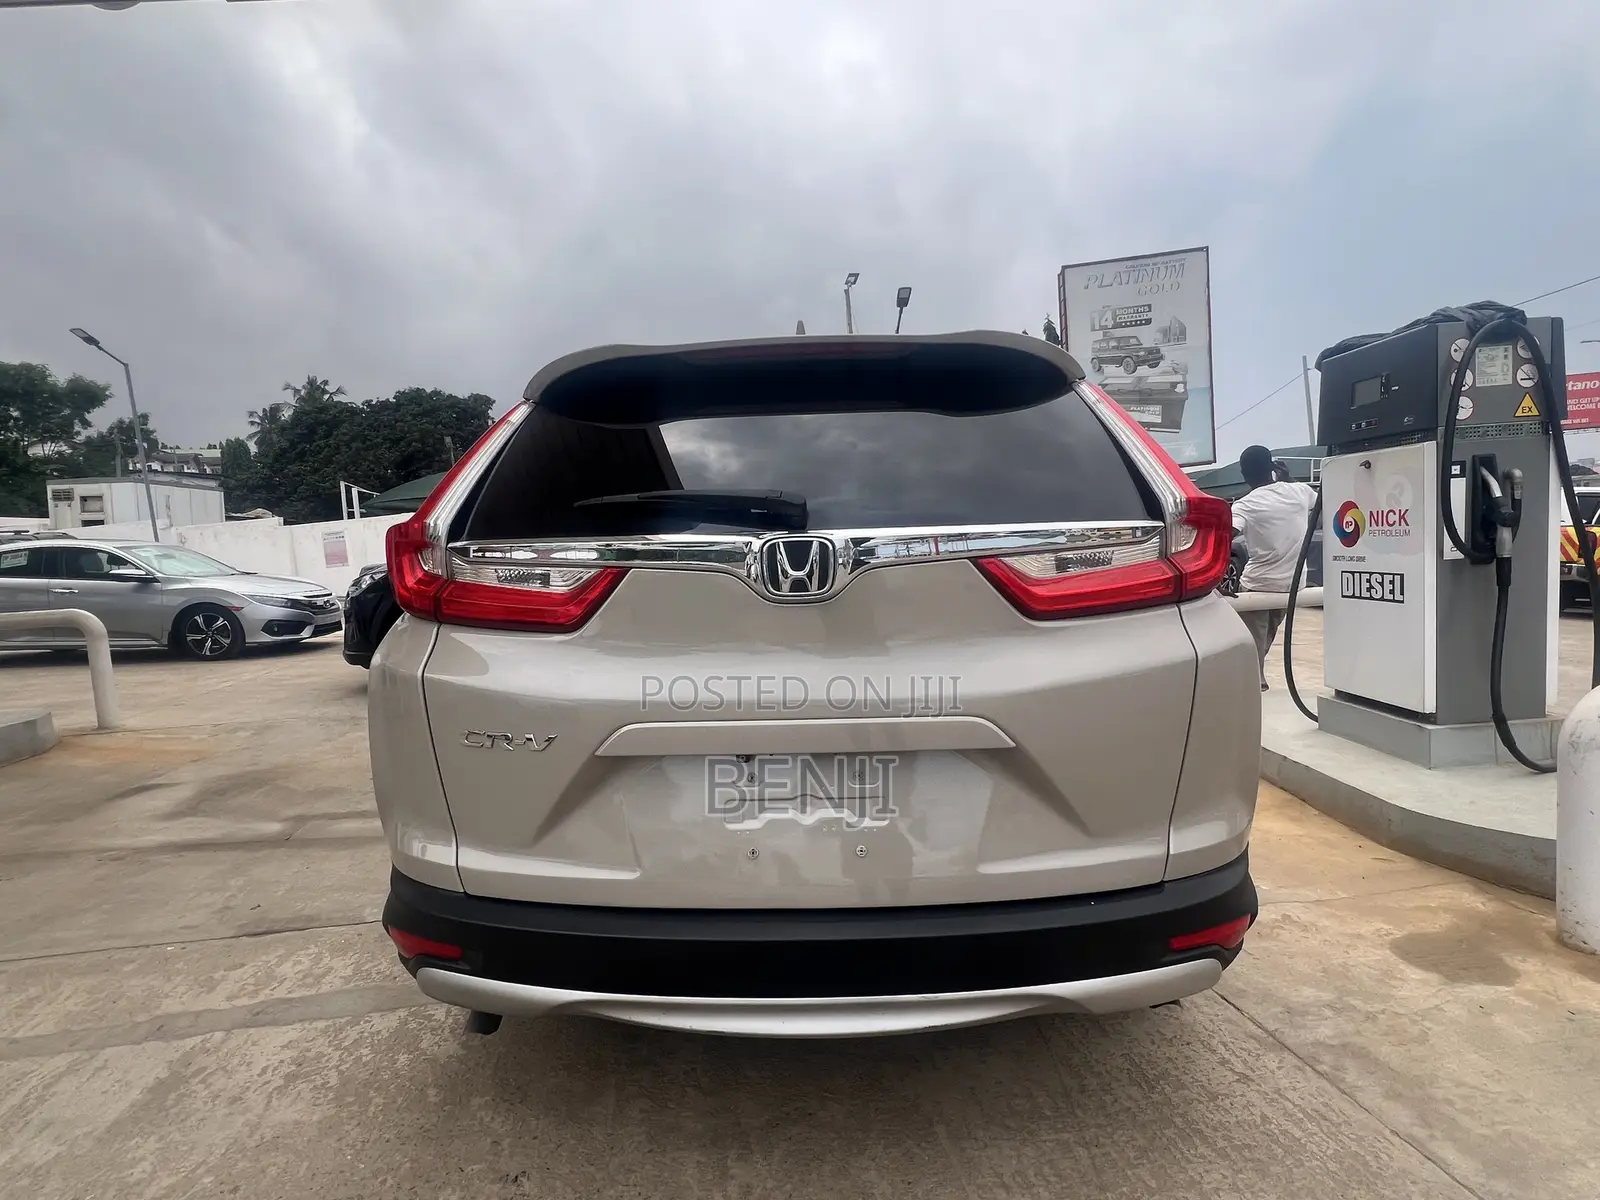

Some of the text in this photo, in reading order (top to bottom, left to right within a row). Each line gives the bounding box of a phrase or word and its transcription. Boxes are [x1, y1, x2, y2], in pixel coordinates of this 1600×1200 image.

[1084, 263, 1185, 289] PLATINUM
[1136, 281, 1180, 296] GOLD
[1116, 305, 1150, 315] MONTHS
[1090, 310, 1114, 330] 14
[1566, 380, 1600, 390] tano
[1521, 406, 1533, 414] EX
[1369, 508, 1410, 528] NICK
[1368, 529, 1411, 538] PETROLEUM
[1342, 572, 1404, 601] DIESEL
[463, 728, 558, 752] CR-V
